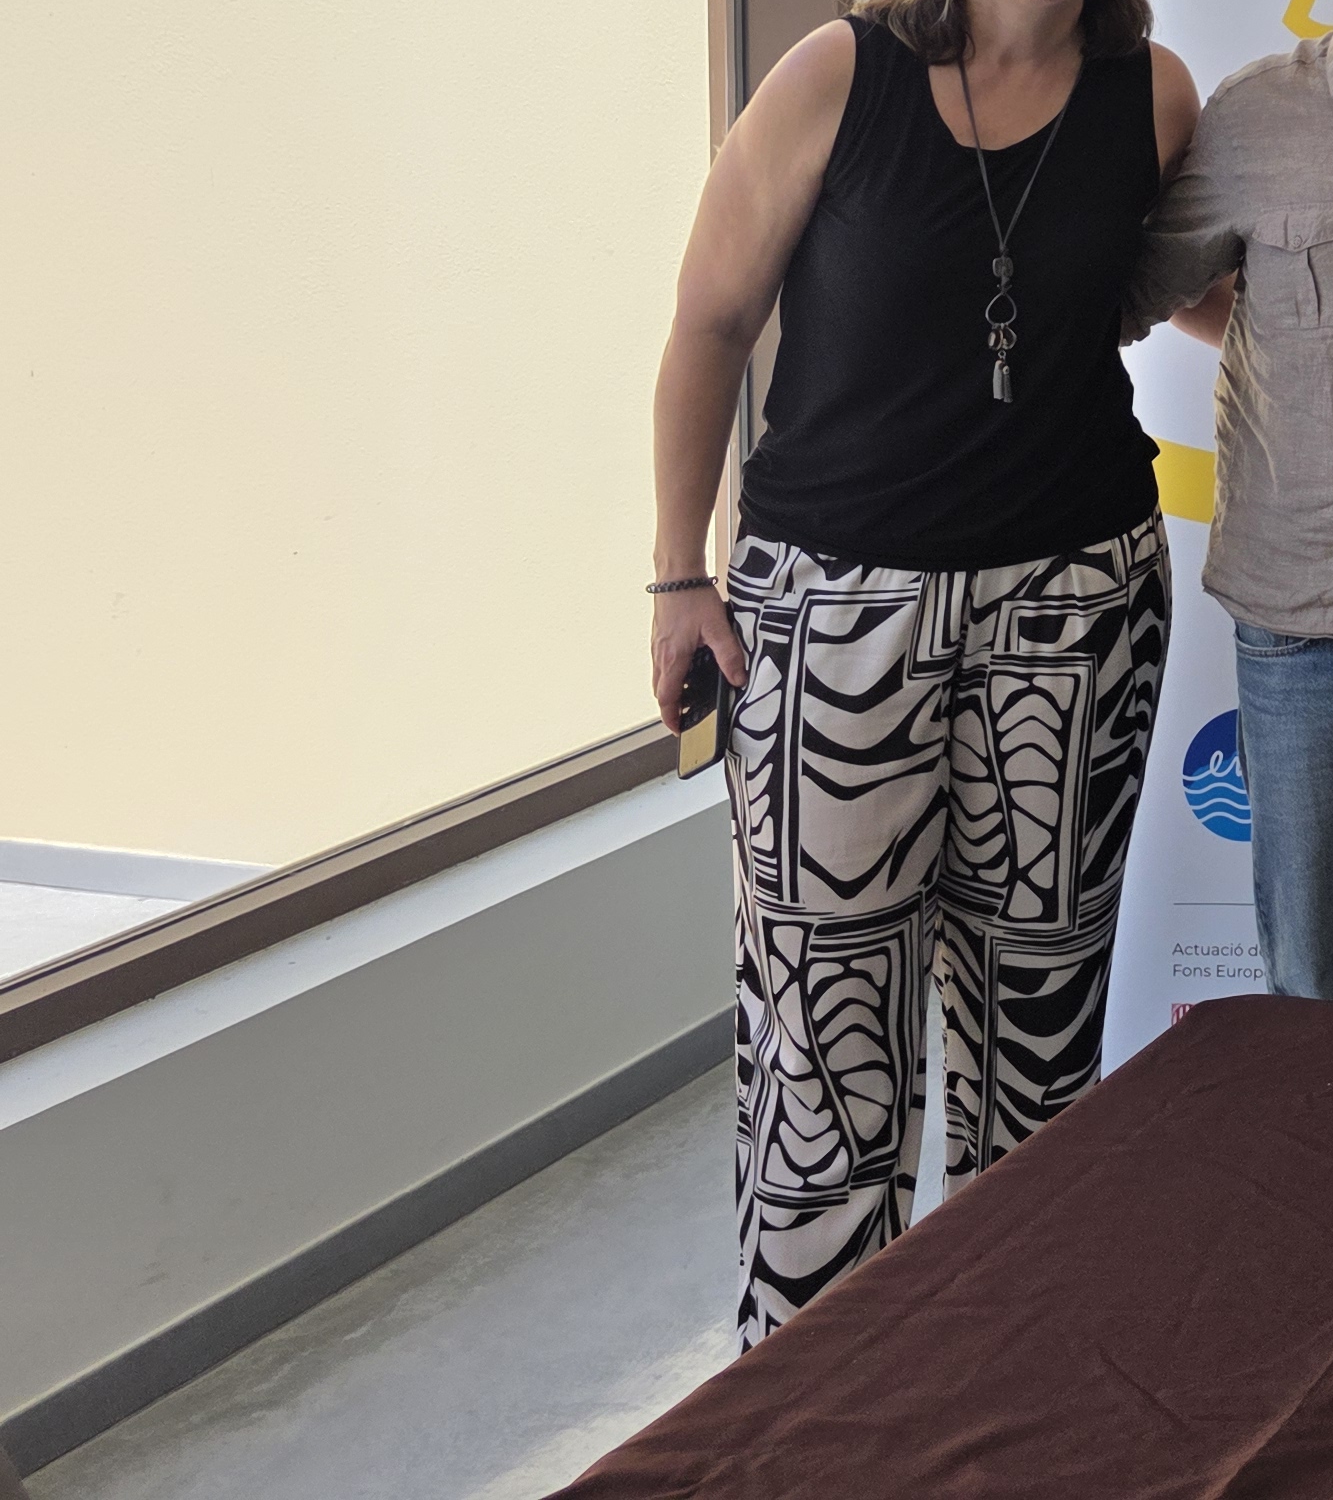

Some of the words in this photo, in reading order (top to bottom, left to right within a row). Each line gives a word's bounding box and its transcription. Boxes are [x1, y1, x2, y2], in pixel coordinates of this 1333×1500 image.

[1172, 942, 1244, 957] Actuació
[1172, 964, 1212, 978] Fons
[1216, 964, 1267, 981] Europ
